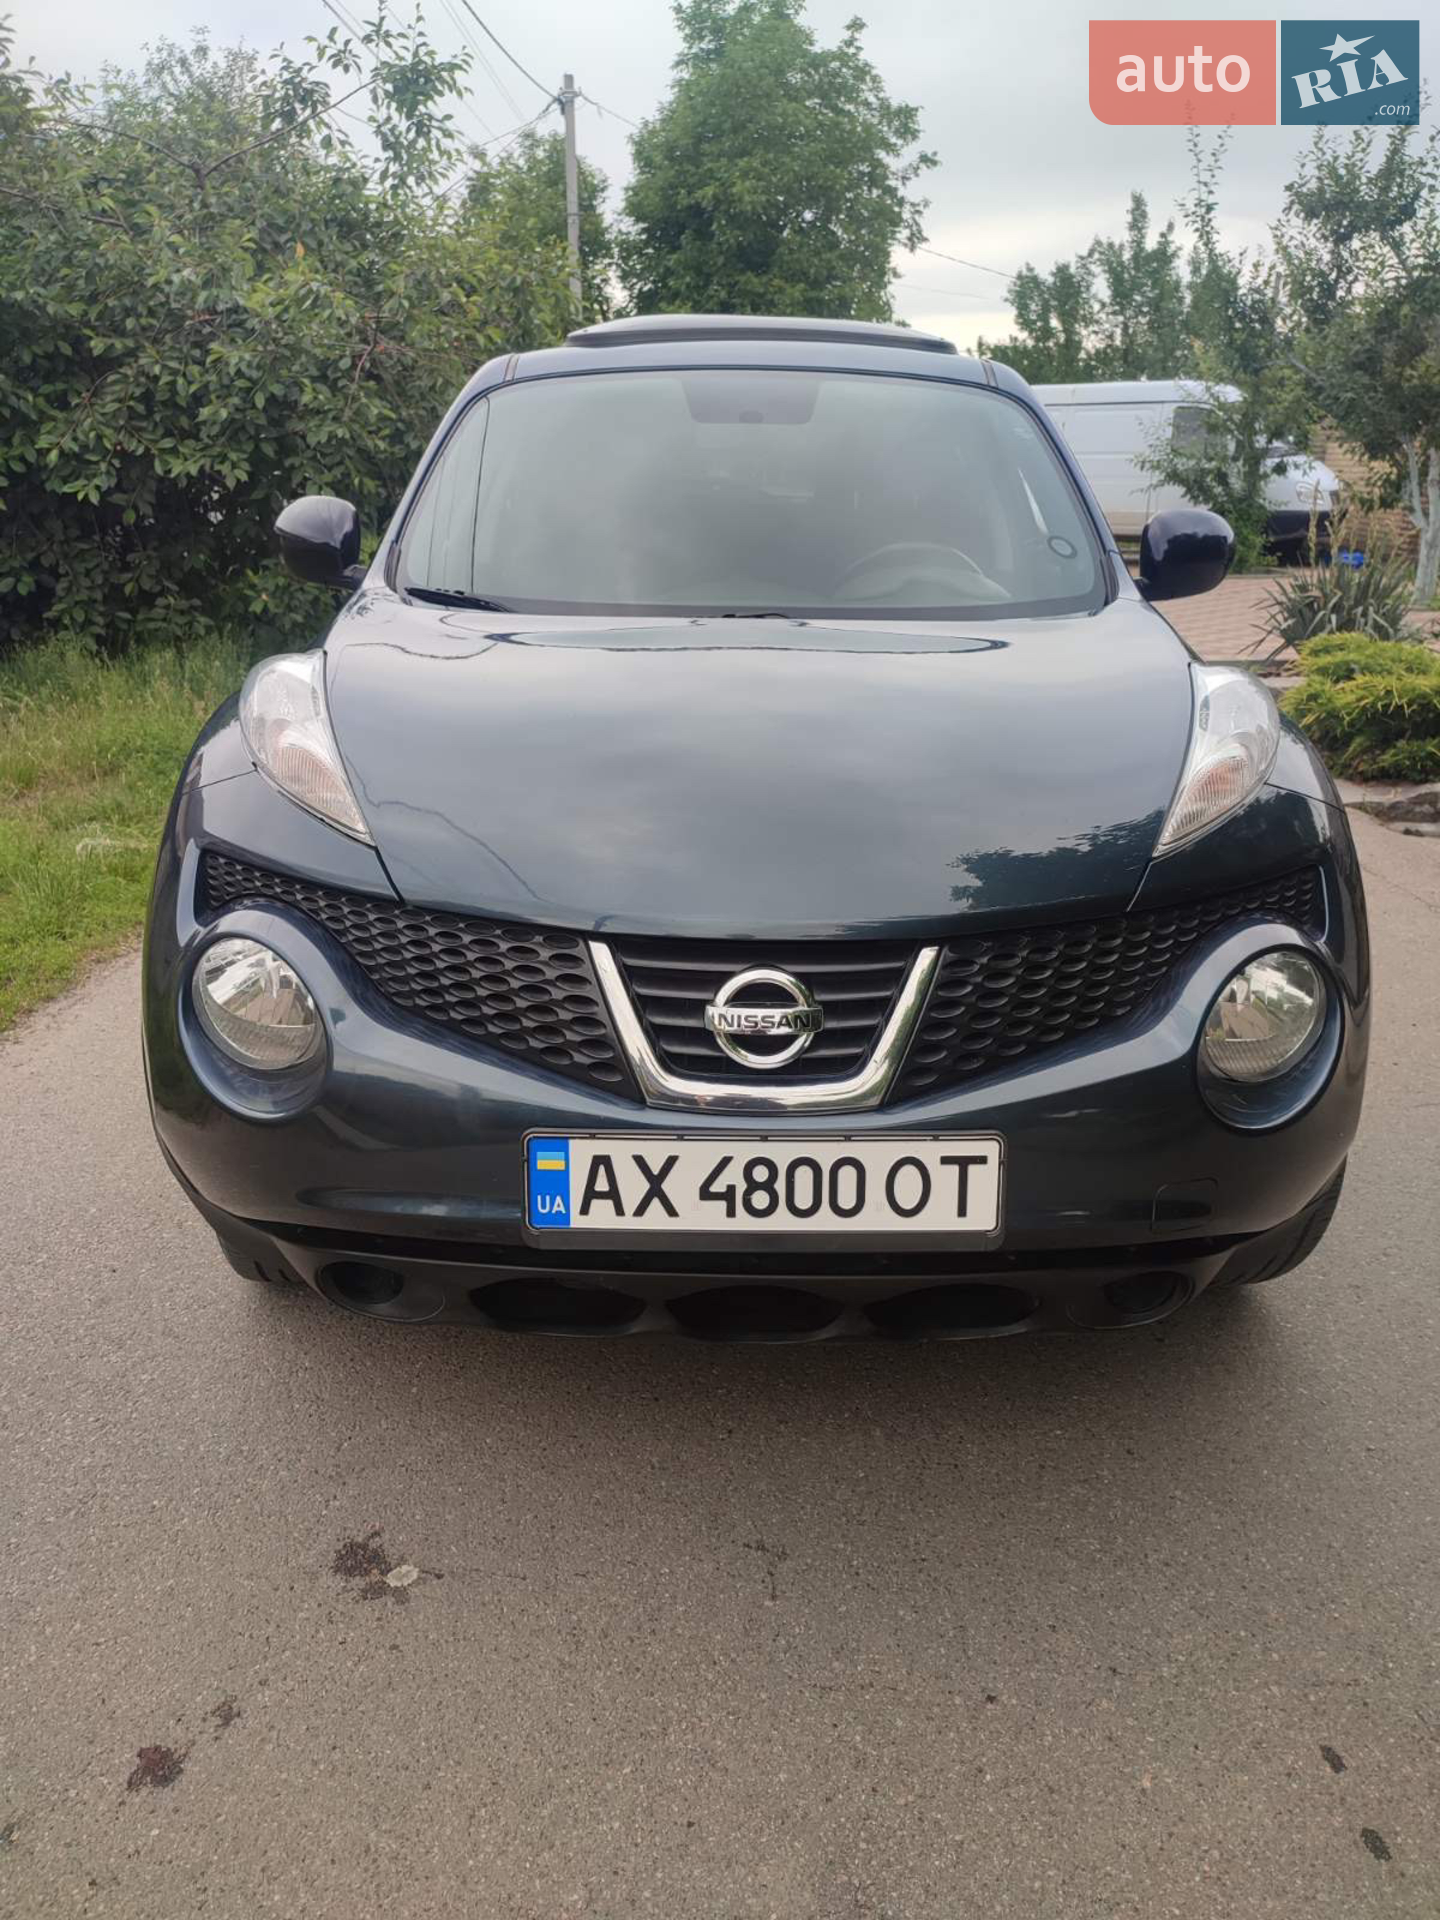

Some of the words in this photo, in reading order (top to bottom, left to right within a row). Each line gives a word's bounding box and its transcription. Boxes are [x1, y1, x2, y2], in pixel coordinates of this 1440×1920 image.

[716, 1013, 811, 1029] NISSAN
[579, 1154, 680, 1218] AX
[698, 1155, 867, 1219] 4800
[885, 1154, 989, 1218] OT
[537, 1194, 567, 1214] UA
